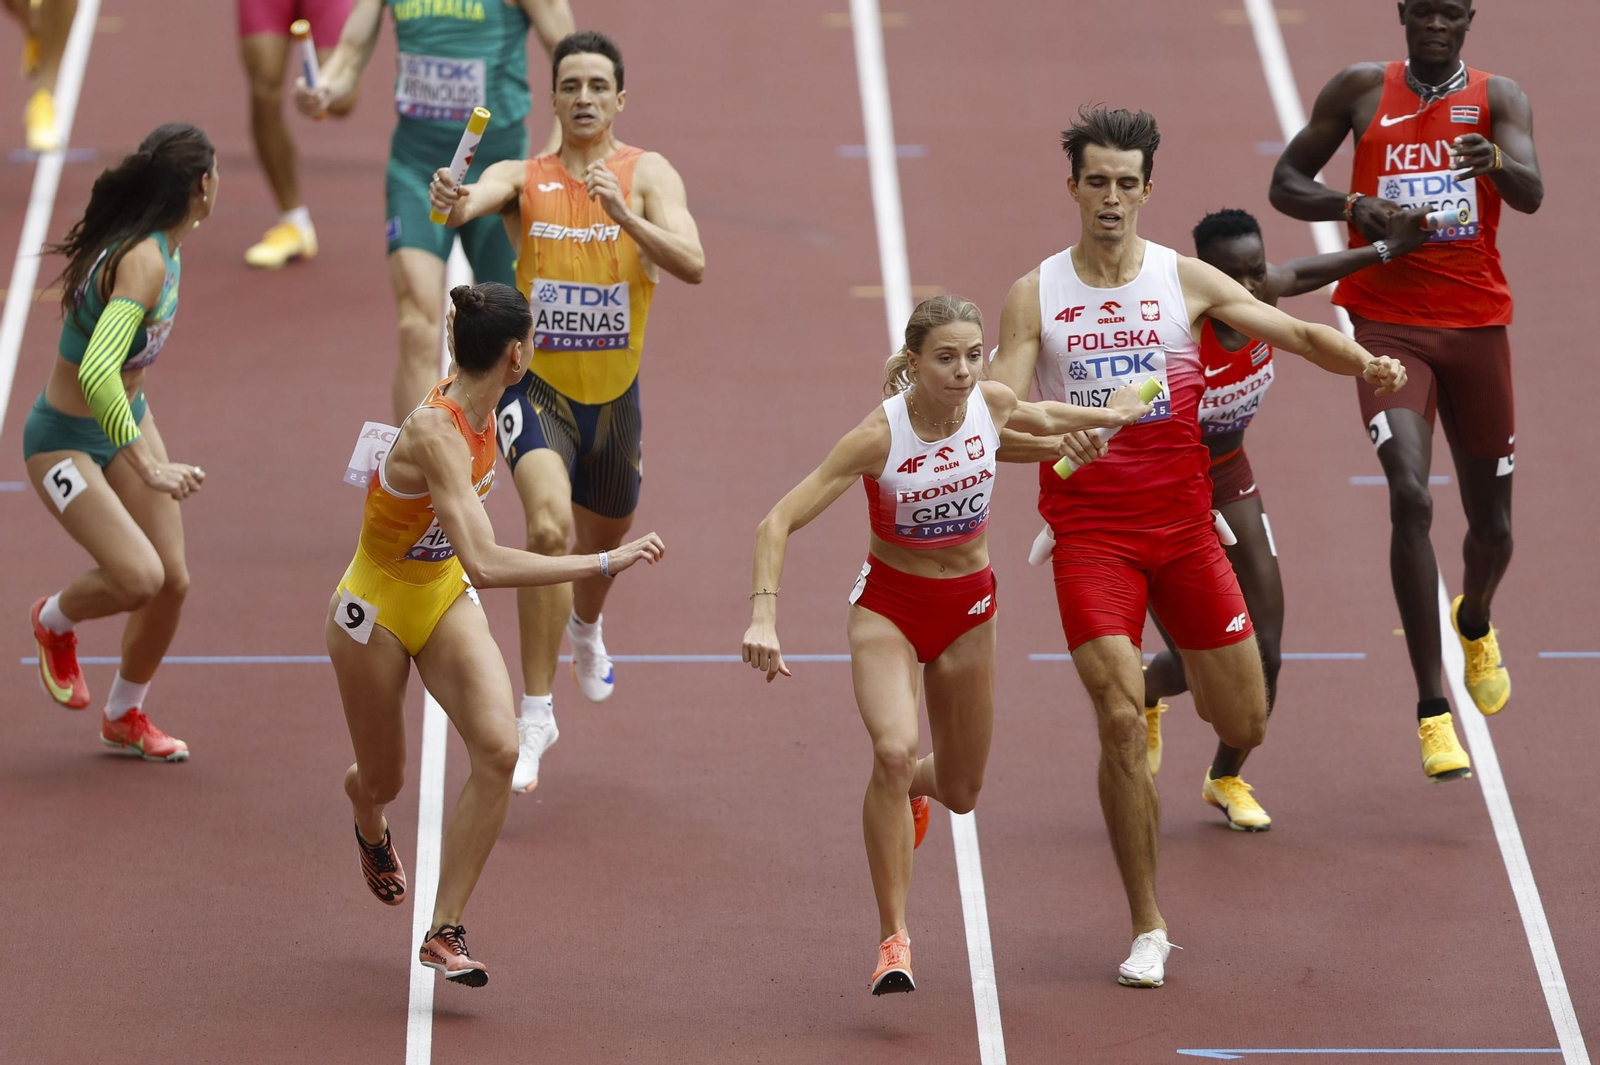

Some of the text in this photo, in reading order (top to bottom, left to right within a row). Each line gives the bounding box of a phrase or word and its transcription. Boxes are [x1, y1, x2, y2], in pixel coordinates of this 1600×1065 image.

[1385, 139, 1466, 171] KENY
[1400, 174, 1467, 197] TDK
[559, 285, 622, 306] TDK
[536, 309, 625, 332] ARENAS
[1097, 316, 1125, 325] ORLEN
[1067, 329, 1160, 352] POLSKA
[1085, 352, 1157, 379] TDK
[1201, 372, 1272, 409] HONDA
[933, 461, 960, 473] ORLEN
[52, 469, 73, 499] 5
[900, 469, 993, 504] HONDA
[912, 493, 984, 524] GRYC
[345, 602, 365, 629] 9
